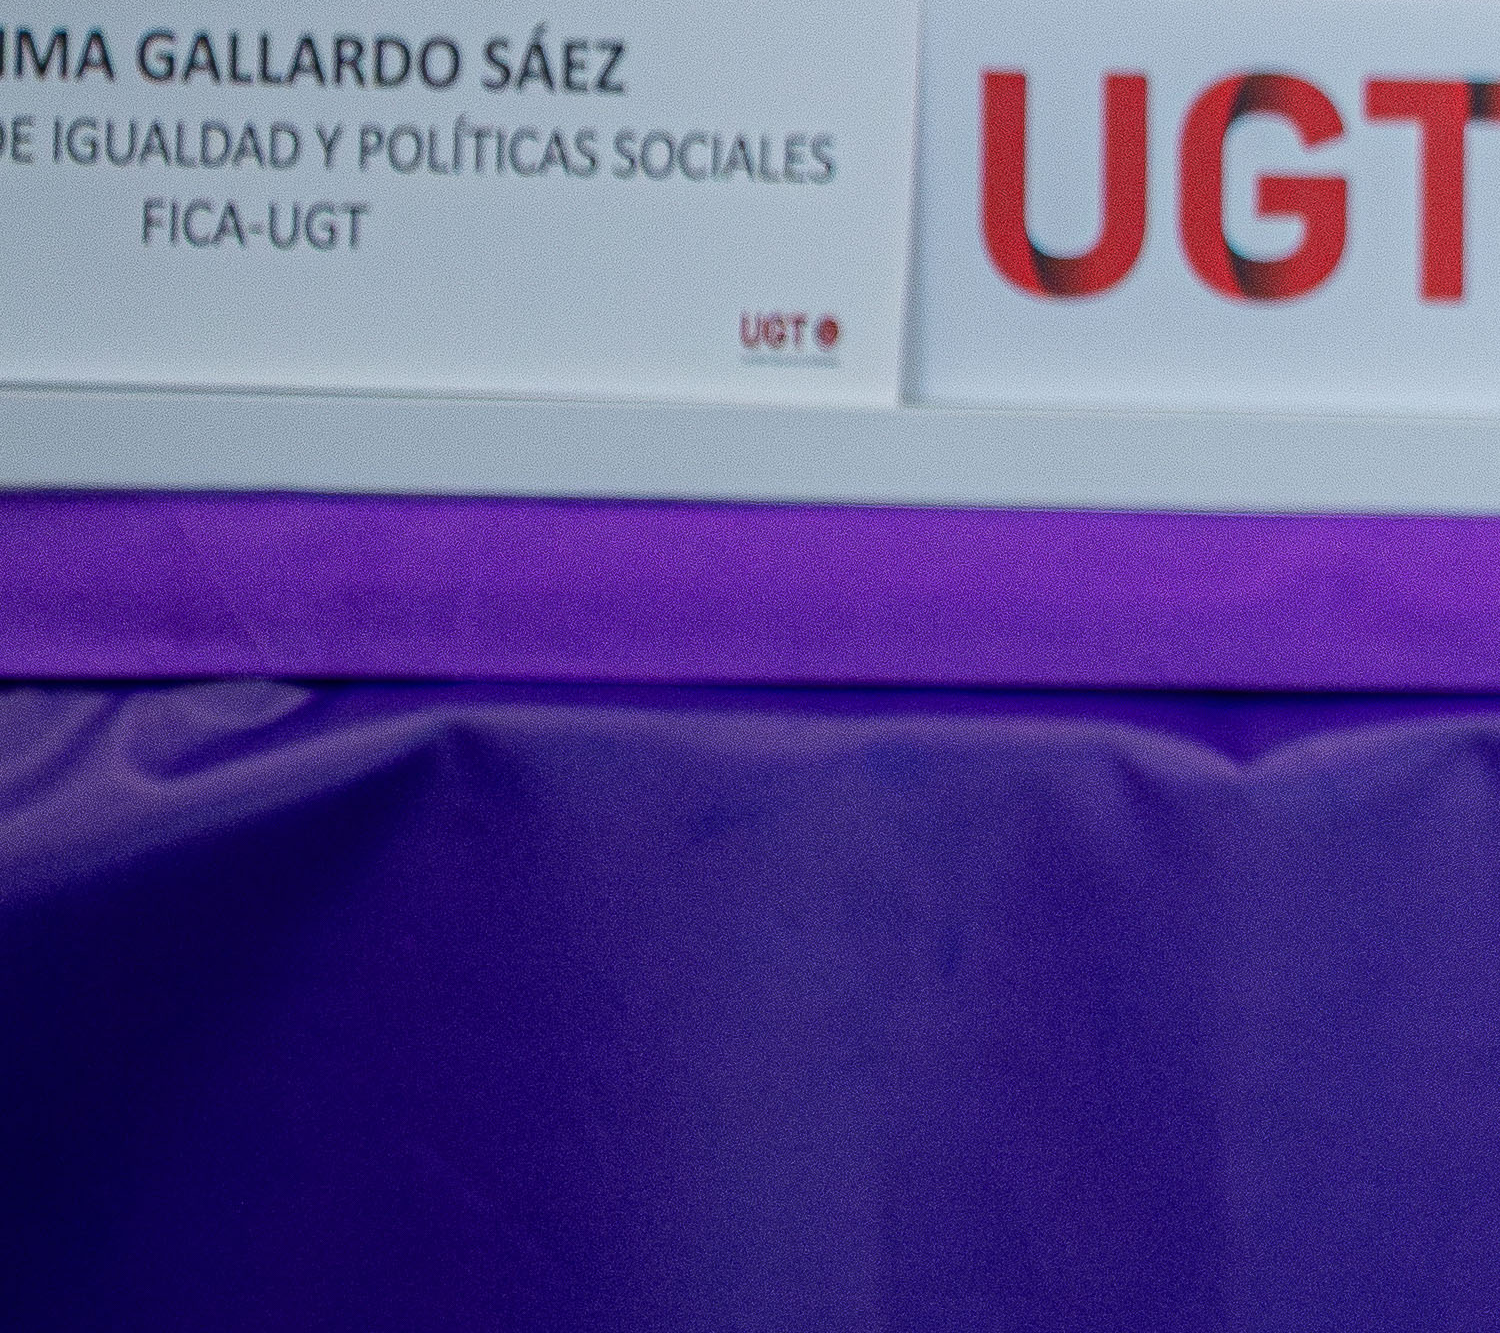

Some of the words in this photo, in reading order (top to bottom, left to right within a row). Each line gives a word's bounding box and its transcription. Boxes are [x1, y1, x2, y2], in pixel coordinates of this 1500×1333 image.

[0, 26, 115, 80] MA
[137, 29, 461, 90] GALLARDO
[481, 20, 628, 95] SÁEZ
[0, 114, 35, 166] E
[52, 116, 299, 170] IGUALDAD
[315, 123, 347, 170] Y
[358, 113, 599, 179] POLÍTICAS
[611, 130, 837, 185] SOCIALES
[141, 197, 370, 251] FICA-UGT
[739, 310, 808, 351] UGT
